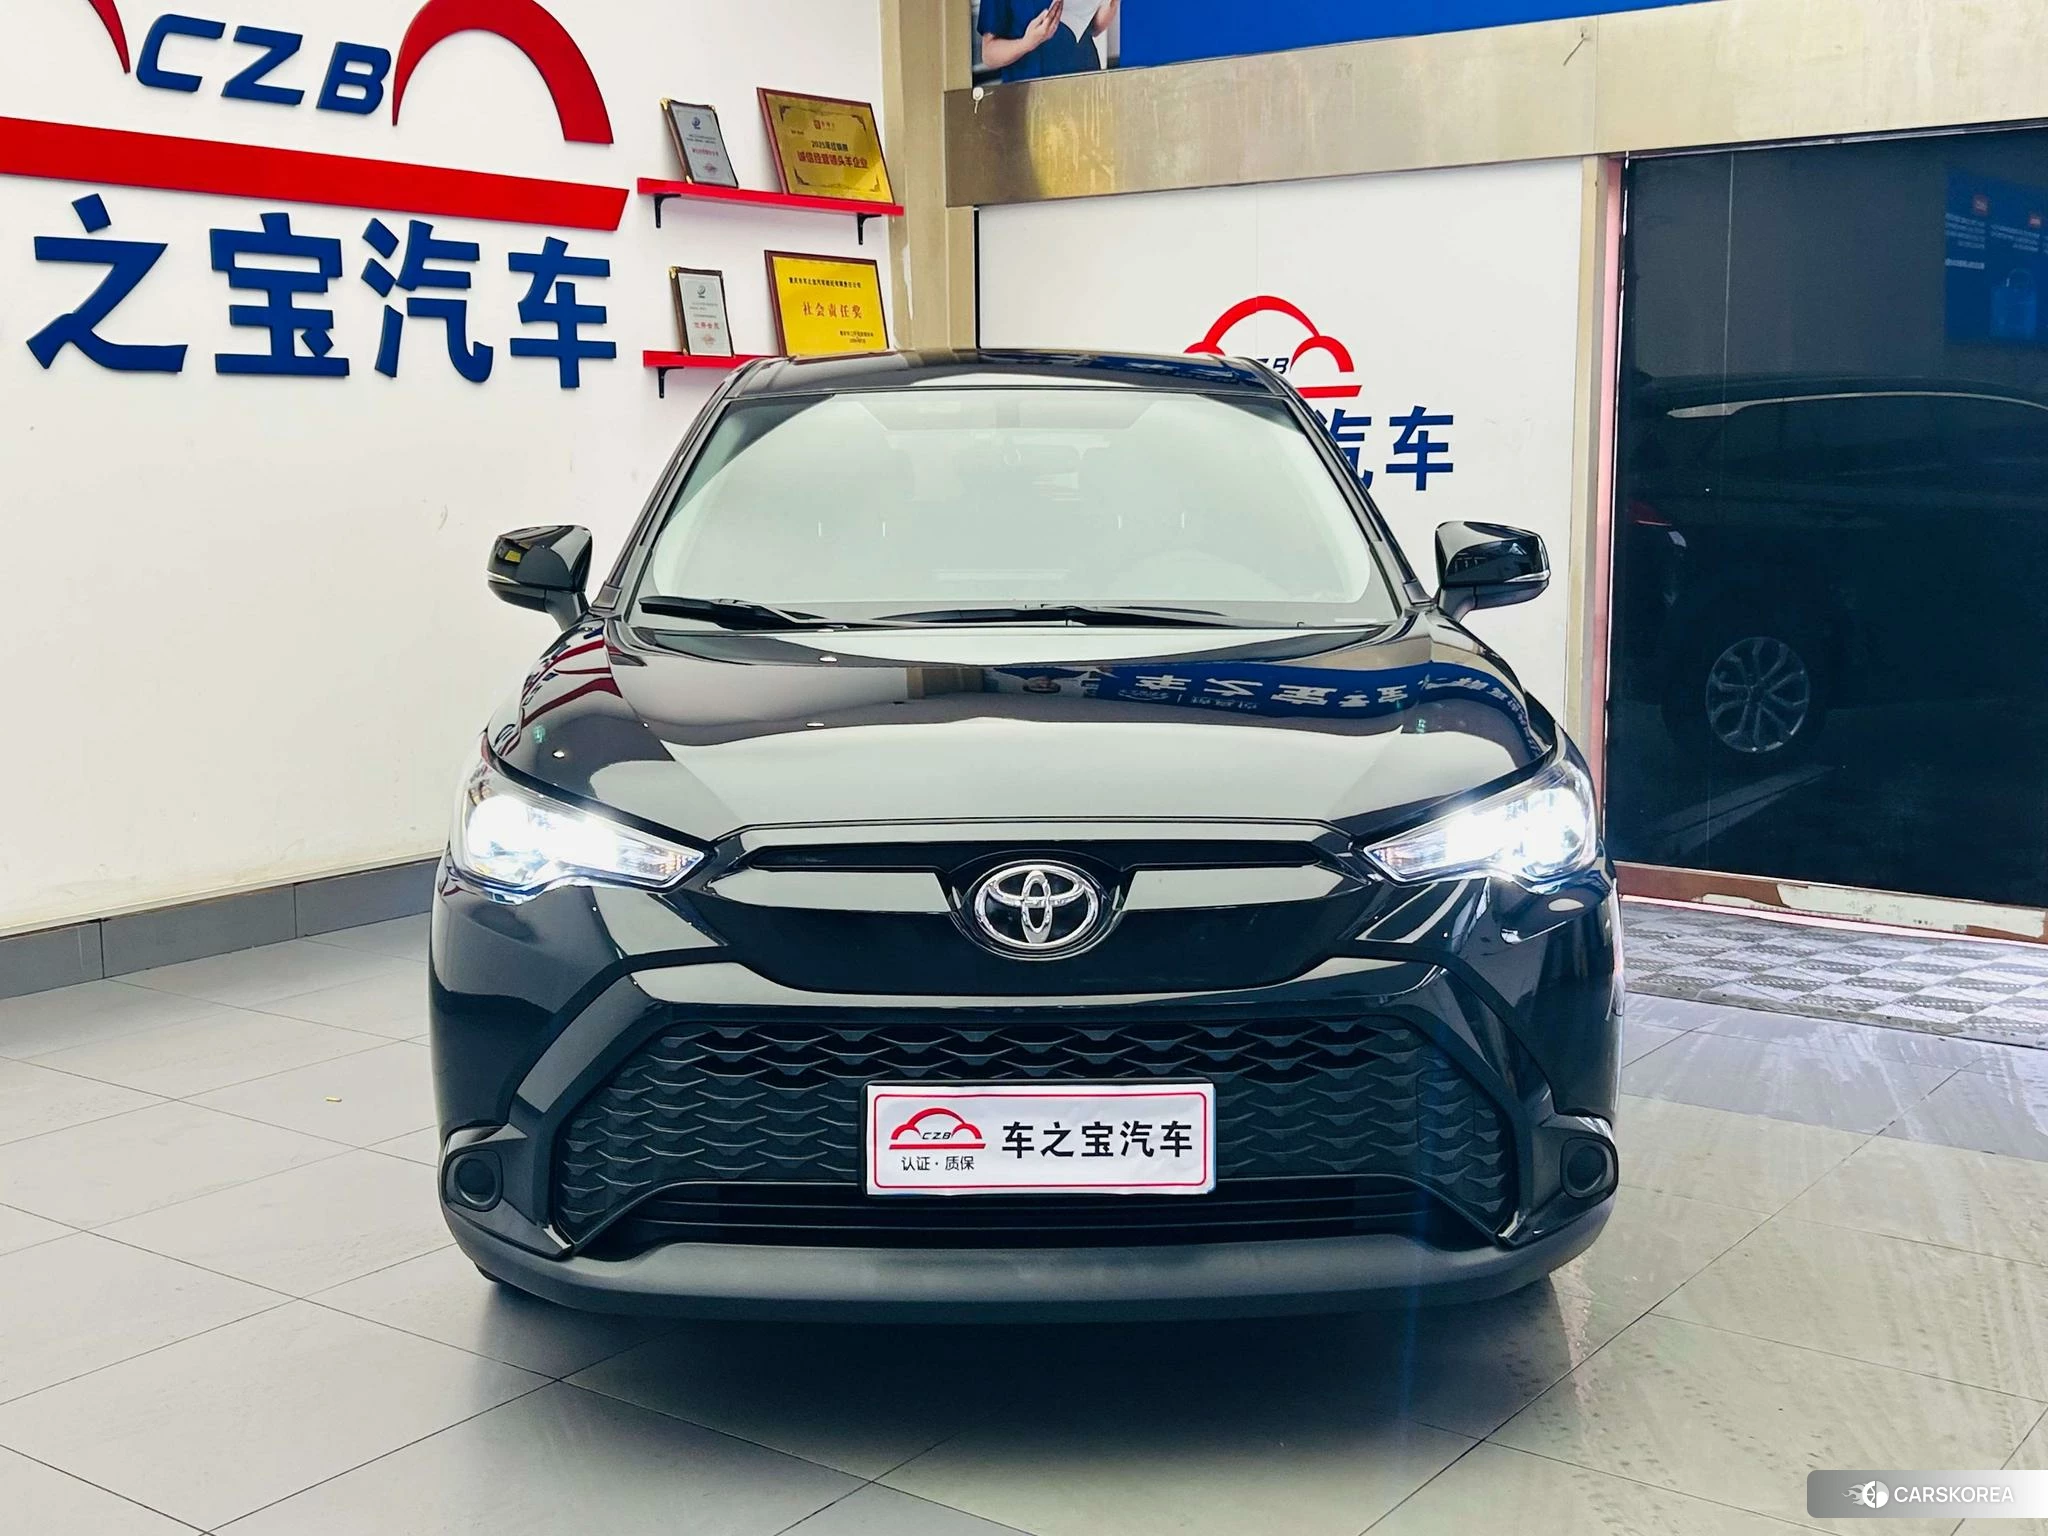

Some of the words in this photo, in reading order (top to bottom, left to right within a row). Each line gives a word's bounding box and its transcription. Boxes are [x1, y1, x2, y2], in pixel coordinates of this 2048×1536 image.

[136, 14, 391, 115] CZB
[28, 193, 616, 389] 之宝汽车
[921, 1131, 953, 1140] CZB
[1001, 1120, 1193, 1159] 车之宝汽车
